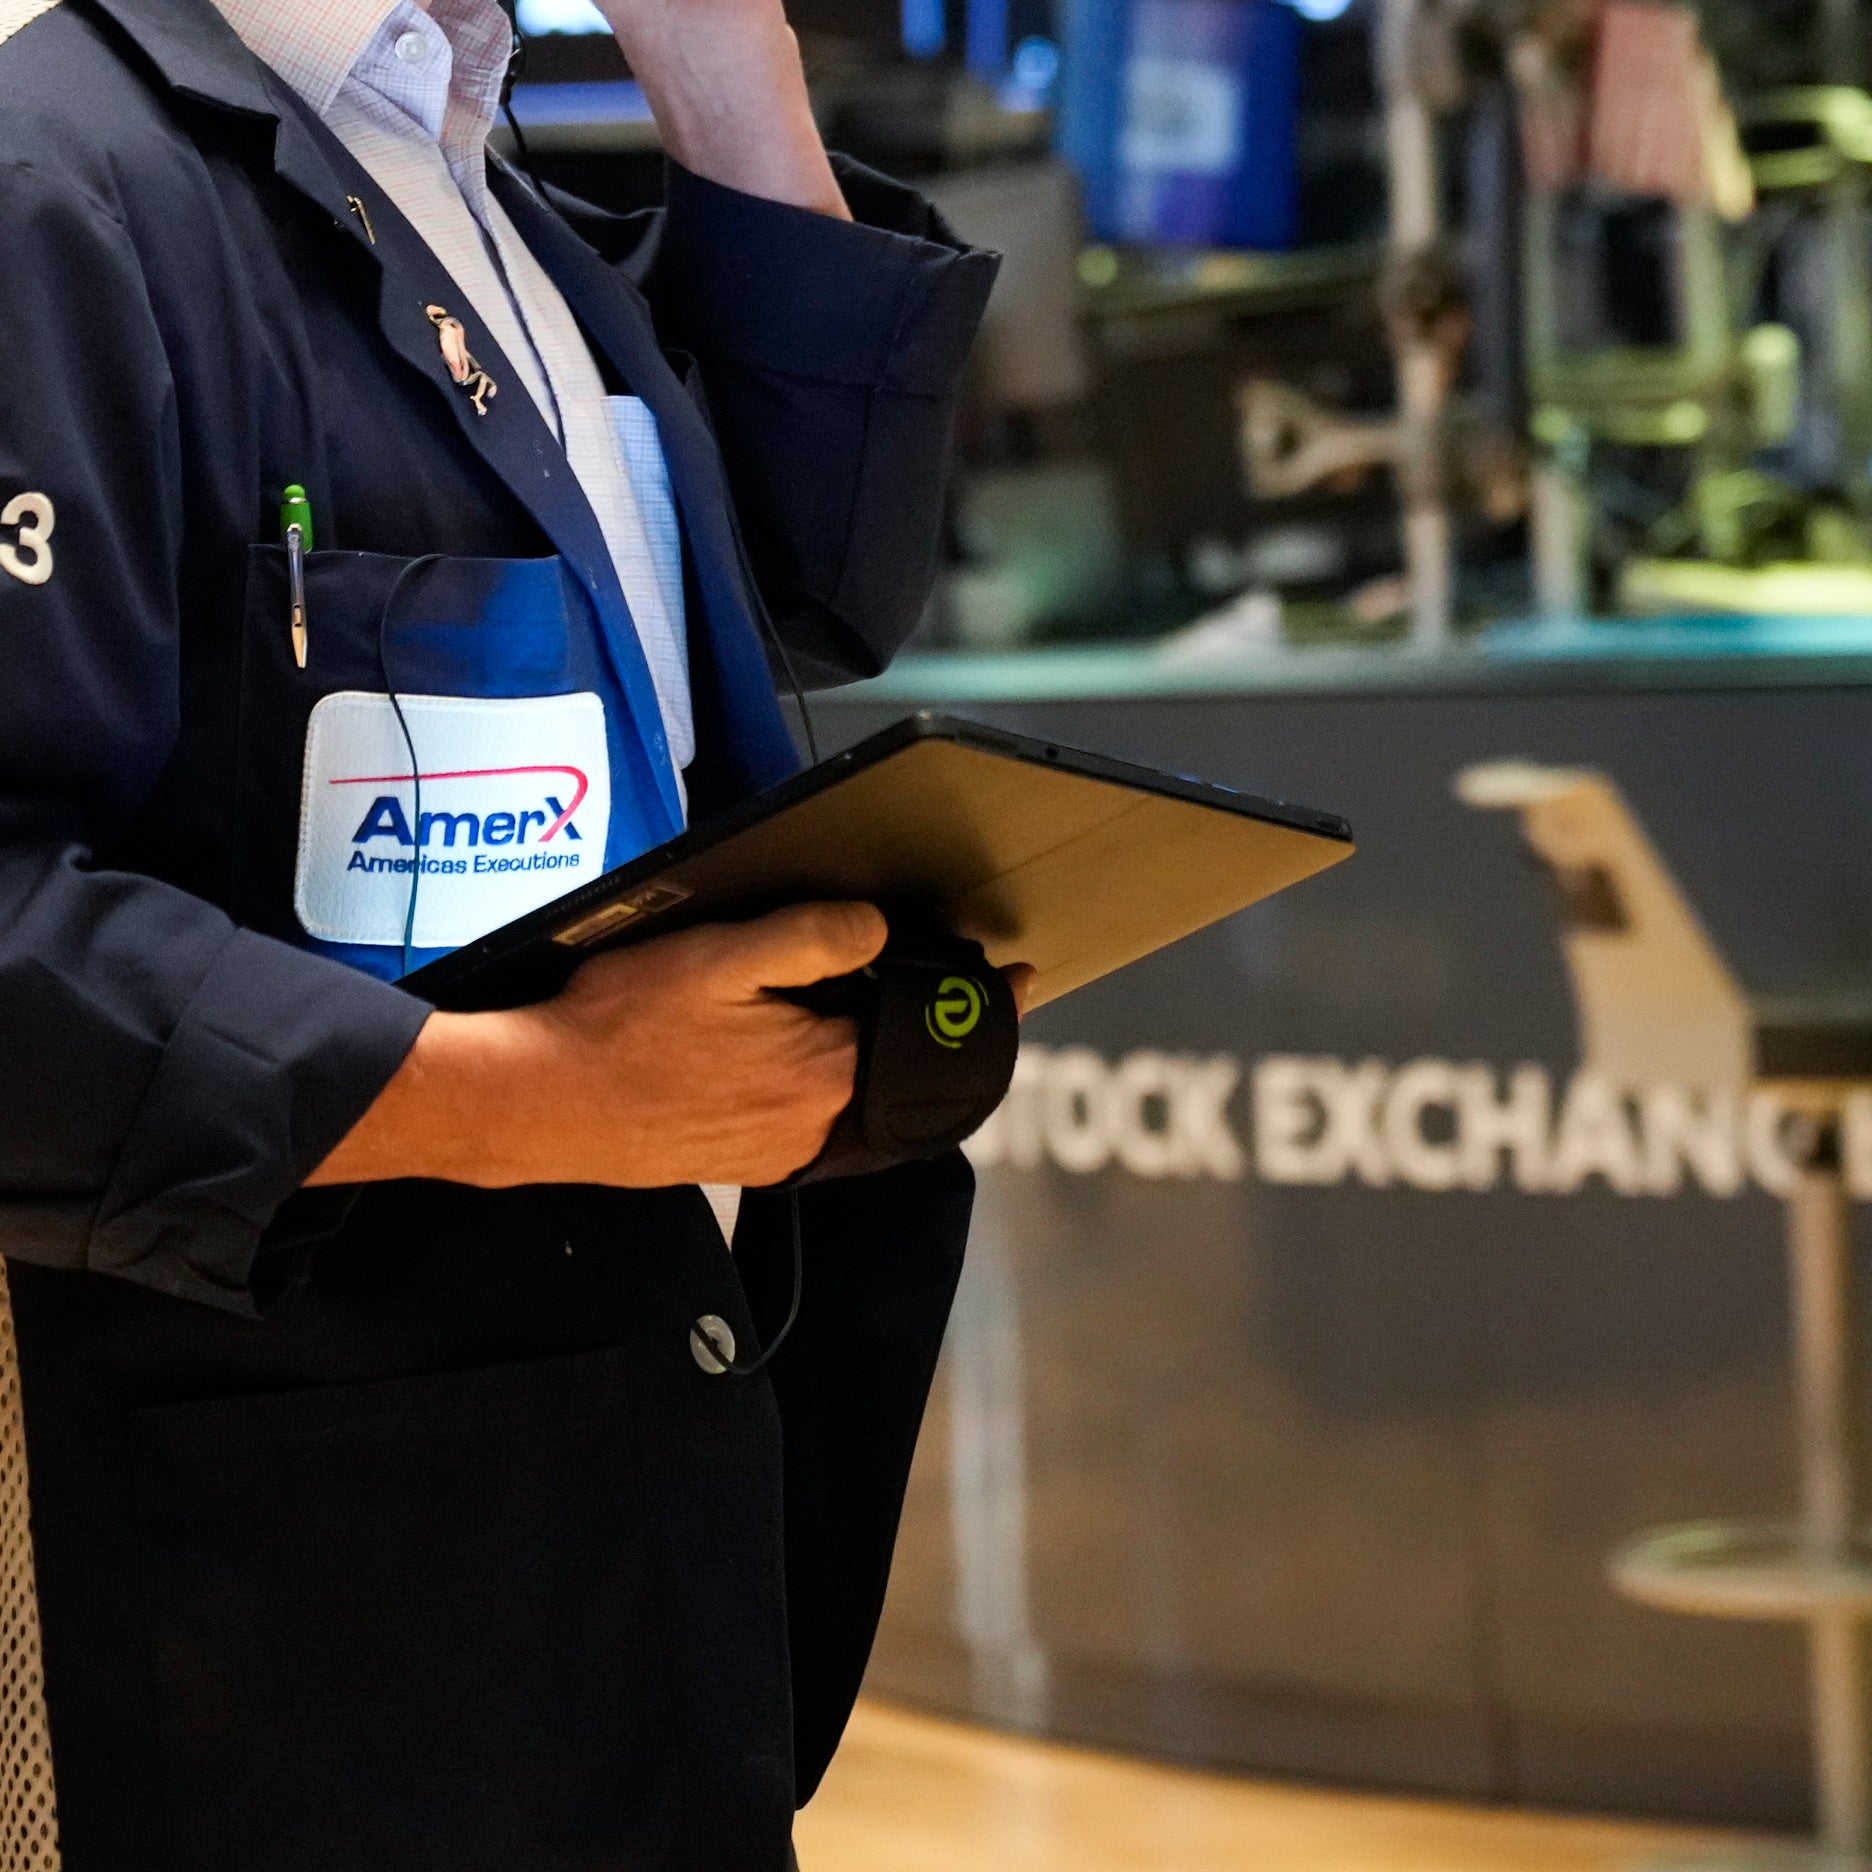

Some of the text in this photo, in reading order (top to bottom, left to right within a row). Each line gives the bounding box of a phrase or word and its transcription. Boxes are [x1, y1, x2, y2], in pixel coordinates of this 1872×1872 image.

[352, 796, 583, 847] AmerX
[347, 850, 580, 874] Americas Executions
[960, 1042, 1244, 1180] TOCK
